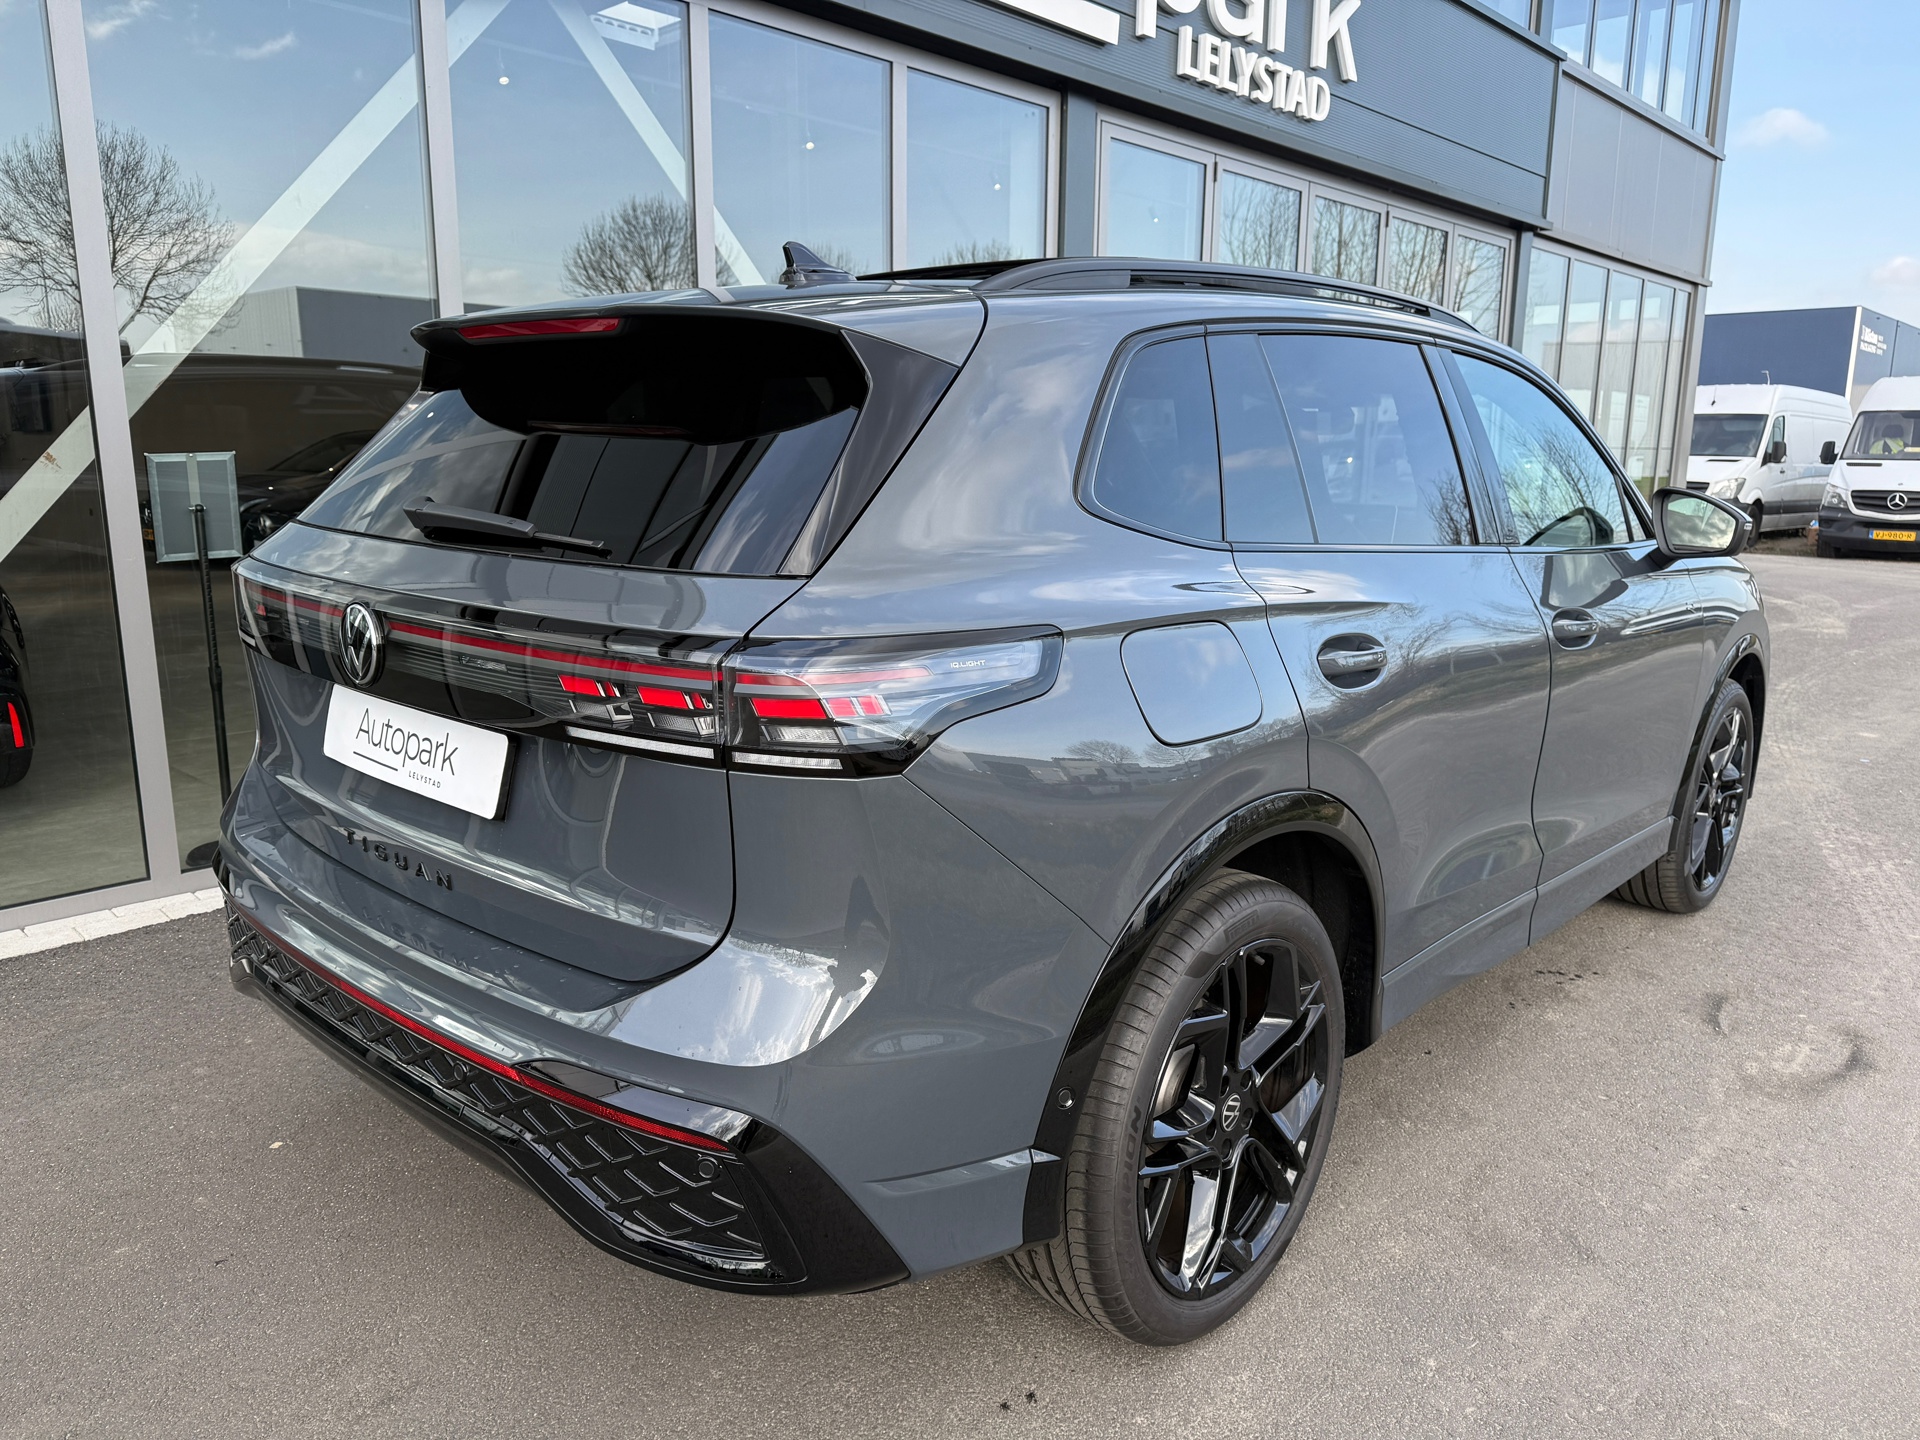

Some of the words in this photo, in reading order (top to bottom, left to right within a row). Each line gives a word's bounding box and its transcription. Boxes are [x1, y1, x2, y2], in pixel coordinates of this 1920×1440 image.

[1176, 25, 1331, 121] LELYSTAD
[950, 660, 986, 669] IQ.LIGHT
[355, 707, 459, 776] Autopark
[408, 770, 442, 789] LELYSTAD
[343, 826, 453, 891] TIGUAN
